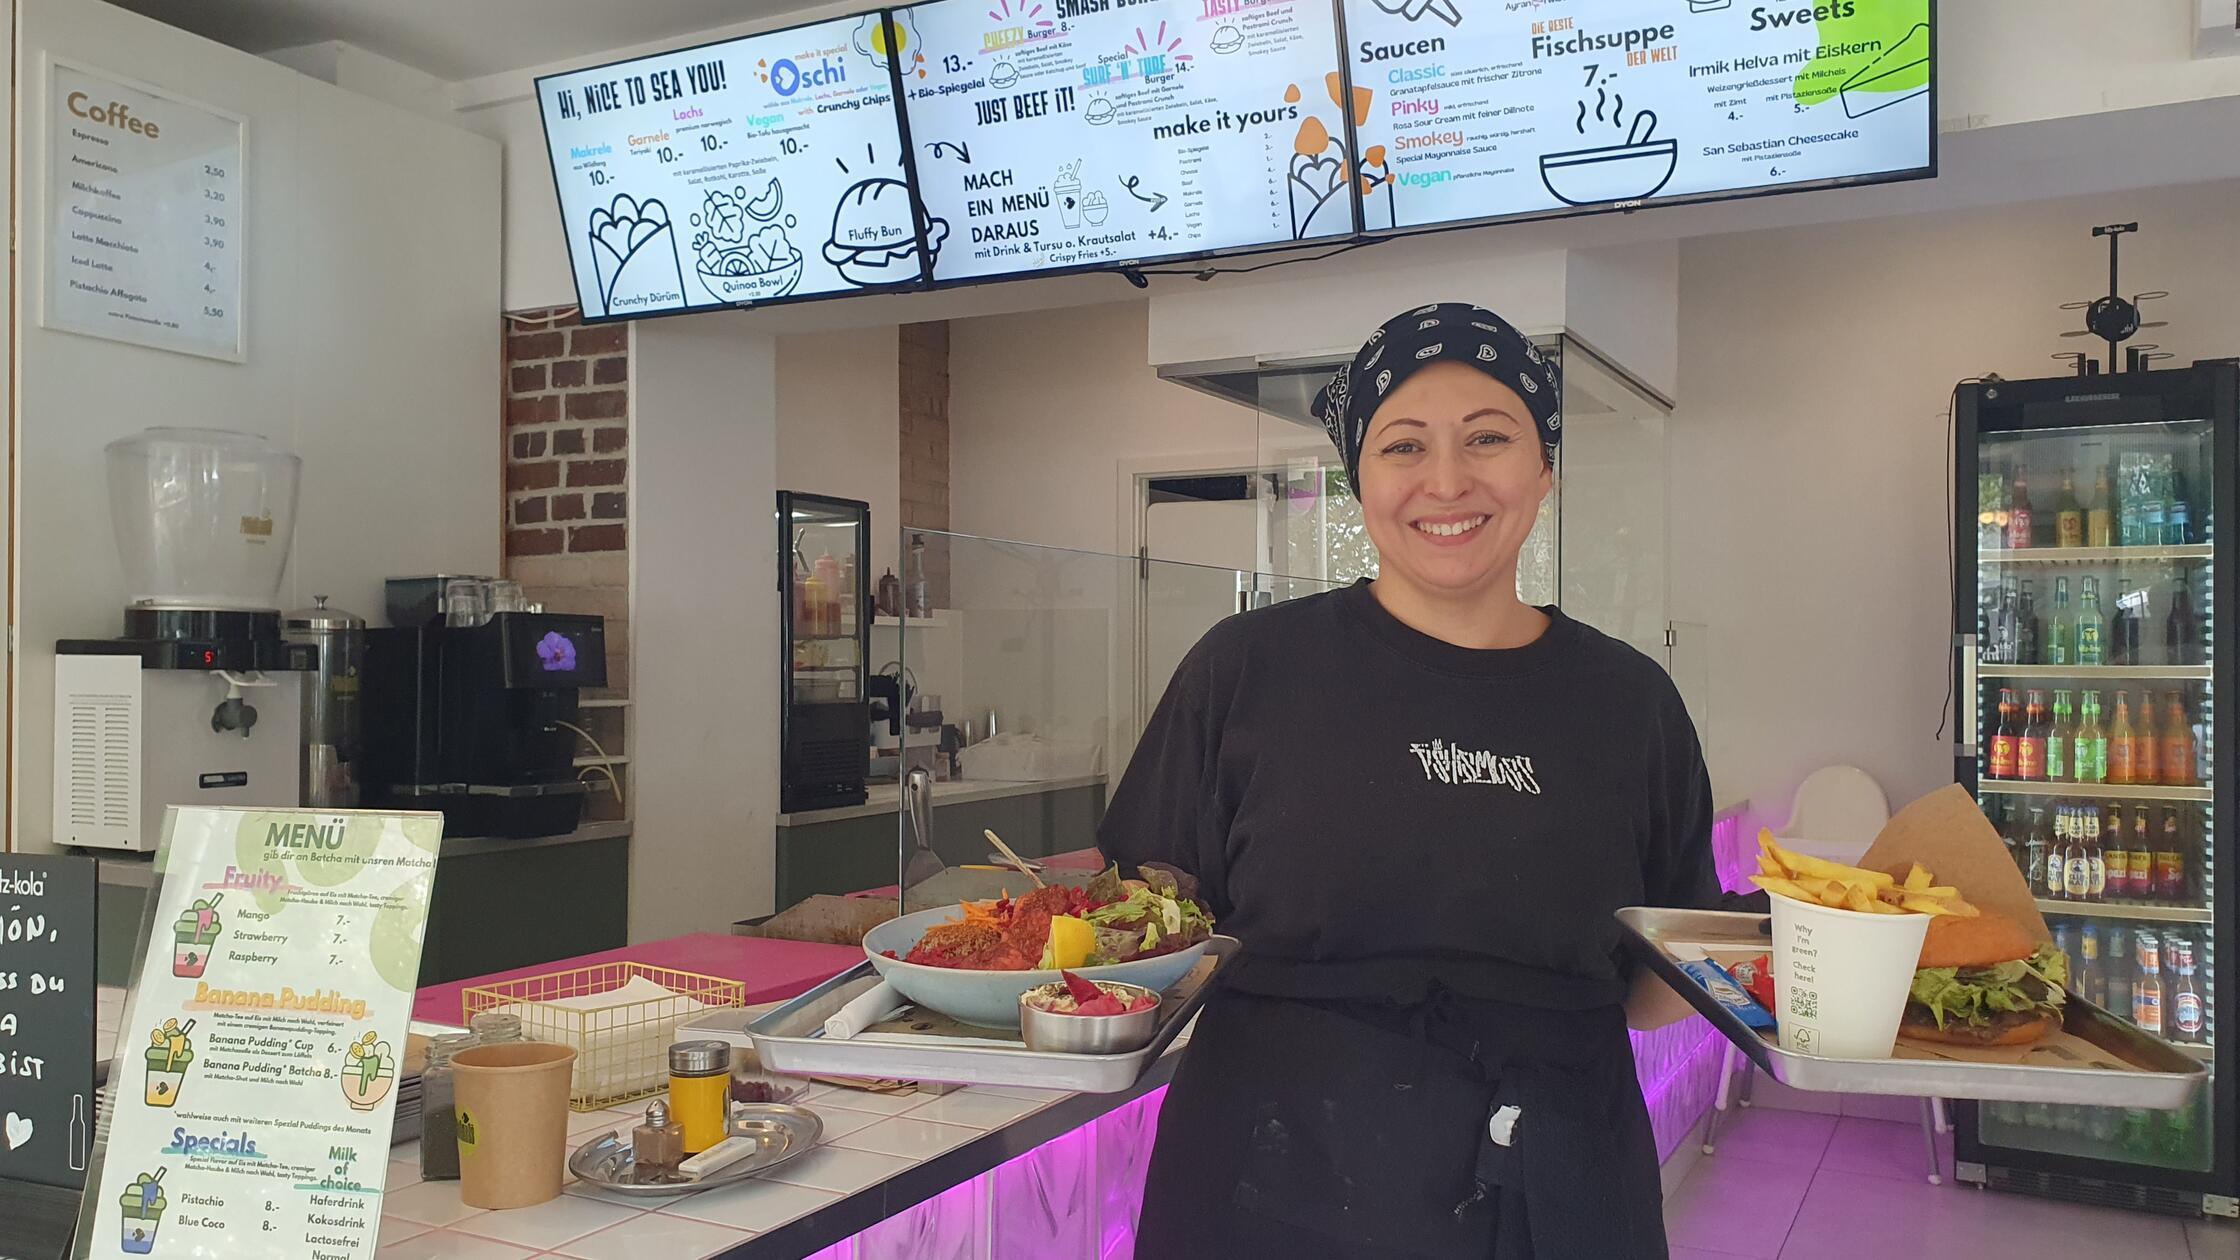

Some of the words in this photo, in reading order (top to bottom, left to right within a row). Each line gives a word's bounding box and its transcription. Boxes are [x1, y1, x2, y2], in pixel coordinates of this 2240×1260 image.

[1056, 0, 1110, 19] SMASH
[1750, 1, 1855, 31] Sweets
[1027, 27, 1056, 39] Burger
[1549, 17, 1574, 32] BESTE
[1360, 36, 1446, 63] Saucen
[1531, 24, 1675, 59] Fischsuppe
[943, 54, 973, 74] 13.-
[1097, 51, 1129, 64] Special
[1626, 52, 1647, 67] DER
[1650, 45, 1678, 64] WELT
[1689, 59, 1729, 78] Irmik
[1733, 55, 1779, 72] Helva
[1783, 48, 1811, 65] mit
[1816, 40, 1882, 60] Eiskern
[1083, 63, 1111, 86] SURF
[1137, 54, 1167, 76] TURF
[1174, 62, 1195, 74] 14.-
[1144, 73, 1175, 85] Burger
[1388, 63, 1446, 84] Classic
[1583, 64, 1618, 87] 7.-
[1707, 75, 1793, 93] Weizengrießdessert
[1794, 71, 1810, 81] mit
[1811, 66, 1847, 78] Milcheis
[557, 89, 582, 121] Hi,
[624, 76, 646, 107] TO
[650, 69, 683, 102] SEA
[686, 59, 727, 95] YOU!
[1389, 80, 1460, 97] Granatapfelsauce
[1461, 77, 1475, 86] mit
[1476, 73, 1509, 84] frischer
[1511, 67, 1543, 79] Zitrone
[817, 98, 861, 114] Crunchy
[862, 94, 891, 107] Chips
[974, 98, 1007, 126] JUST
[1015, 90, 1048, 120] BEEF
[1391, 98, 1439, 117] Pinky
[1714, 100, 1727, 109] mit
[1729, 97, 1747, 106] Zimt
[67, 91, 160, 139] Coffee
[673, 105, 704, 121] Lachs
[746, 113, 785, 128] Vegan
[1153, 114, 1211, 140] make
[1216, 110, 1231, 130] it
[1236, 105, 1298, 133] yours
[1393, 122, 1413, 131] Rosa
[1414, 119, 1433, 128] Sour
[1434, 115, 1461, 125] Cream
[1462, 112, 1476, 121] mit
[1478, 109, 1502, 119] feiner
[1503, 104, 1535, 115] Dillnote
[72, 128, 109, 146] Espresso
[628, 129, 670, 146] Garnele
[700, 134, 729, 152] 10.-
[1394, 130, 1464, 151] Smokey
[1702, 146, 1725, 156] San
[1727, 138, 1785, 153] Sebastian
[1788, 128, 1859, 145] Cheesecake
[570, 142, 612, 160] Makrele
[656, 146, 684, 164] 10.-
[1396, 154, 1423, 166] Special
[1424, 147, 1472, 161] Mayonnaise
[1473, 144, 1497, 154] Sauce
[71, 155, 118, 174] Americano
[589, 169, 615, 187] 10.-
[963, 169, 1014, 192] MACH
[1398, 169, 1452, 189] Vegan
[967, 198, 994, 217] EIN
[1002, 187, 1050, 213] MENÜ
[72, 205, 122, 225] Cappuccino
[848, 226, 878, 242] Fluffy
[881, 225, 902, 238] Bun
[971, 219, 1040, 243] DARAUS
[72, 231, 94, 244] Latte
[95, 236, 139, 254] Macchiato
[974, 249, 991, 259] mit
[993, 244, 1021, 257] Drink
[1023, 243, 1032, 253] &
[1034, 240, 1063, 252] Tursu
[1065, 240, 1076, 248] o.
[1078, 230, 1136, 246] Krautsalat
[1049, 252, 1076, 264] Crispy
[1078, 249, 1098, 260] Fries
[69, 279, 109, 296] Pistachio
[110, 287, 148, 303] Affogato
[723, 280, 757, 293] Quinoa
[759, 276, 783, 287] Bowl
[612, 293, 648, 307] Crunchy
[650, 291, 680, 302] Dürüm
[203, 306, 224, 318] 5,50
[264, 818, 345, 850] MENÜ
[264, 851, 279, 862] gib
[281, 851, 295, 861] dir
[296, 853, 309, 861] an
[311, 851, 342, 863] Batcha
[344, 854, 361, 864] mit
[362, 857, 395, 866] unsren
[396, 856, 432, 868] Matcha
[223, 865, 283, 893] Fruity
[237, 909, 270, 921] Mango
[336, 915, 350, 926] 7.-
[233, 930, 288, 944] Strawberry
[332, 934, 347, 944] 7.-
[1794, 923, 1813, 936] Why
[228, 951, 279, 966] Raspberry
[328, 954, 343, 966] 7.-
[1792, 946, 1818, 958] green?
[1793, 961, 1816, 973] Check
[30, 972, 65, 995] DU
[1794, 971, 1814, 984] here!
[193, 981, 275, 1009] Banana
[279, 986, 366, 1021] Pudding
[209, 1033, 246, 1045] Banana
[294, 1039, 314, 1052] Cup
[327, 1042, 342, 1053] 6.-
[203, 1058, 240, 1070] Banana
[289, 1065, 321, 1077] Batcha
[324, 1069, 338, 1079] 8.-
[171, 1127, 256, 1154] Specials
[329, 1146, 357, 1162] Milk
[334, 1162, 349, 1175] of
[320, 1176, 361, 1191] choice
[181, 1194, 224, 1207] Pistachio
[265, 1201, 280, 1211] 8.-
[310, 1194, 365, 1209] Haferdrink
[178, 1215, 199, 1227] Blue
[201, 1218, 225, 1229] Coco
[262, 1221, 277, 1231] 8.-
[307, 1213, 365, 1228] Kokosdrink
[305, 1232, 360, 1247] Lactosefrei
